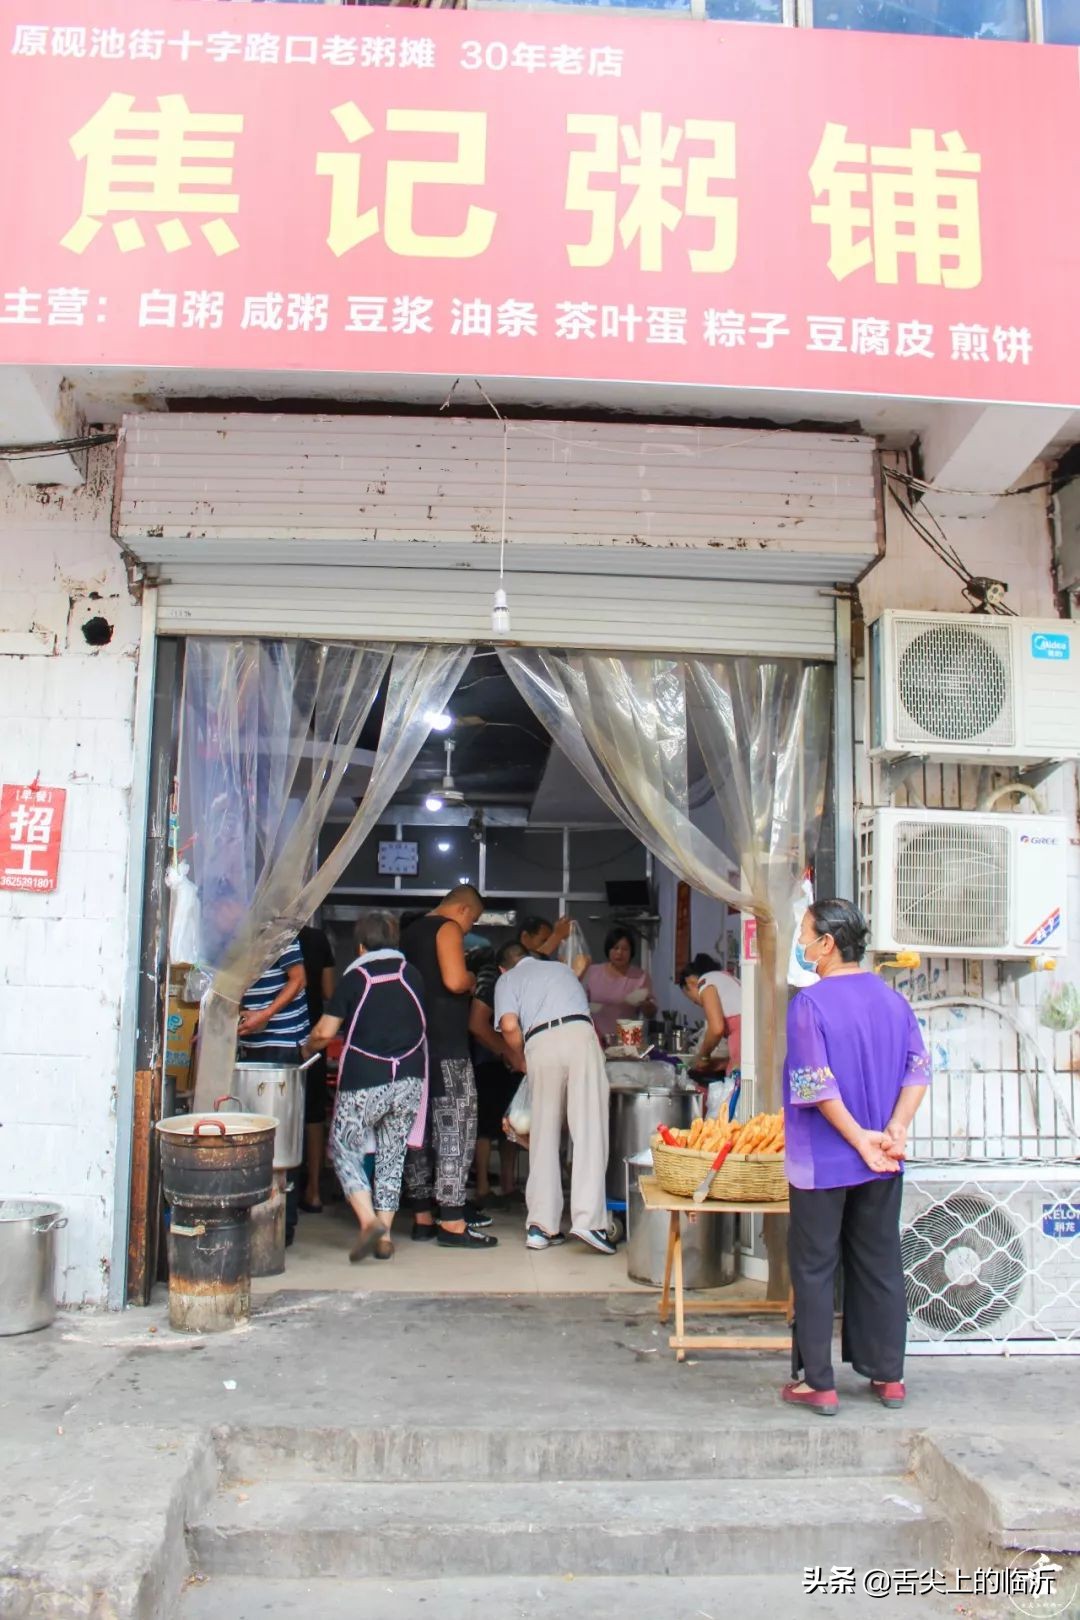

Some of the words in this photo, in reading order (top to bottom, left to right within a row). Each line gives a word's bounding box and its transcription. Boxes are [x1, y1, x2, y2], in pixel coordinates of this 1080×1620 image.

[12, 25, 435, 68] 原砚池街十字路口老粥摊
[461, 41, 624, 77] 30年老店
[60, 92, 981, 289] 焦记粥铺
[138, 290, 223, 330] 白粥
[241, 292, 328, 332] 咸粥
[346, 296, 433, 334] 豆浆
[451, 299, 537, 337] 油条
[556, 302, 687, 345] 茶叶蛋
[704, 309, 789, 348] 粽子
[806, 316, 935, 358] 豆腐皮
[969, 323, 1033, 365] 煎饼
